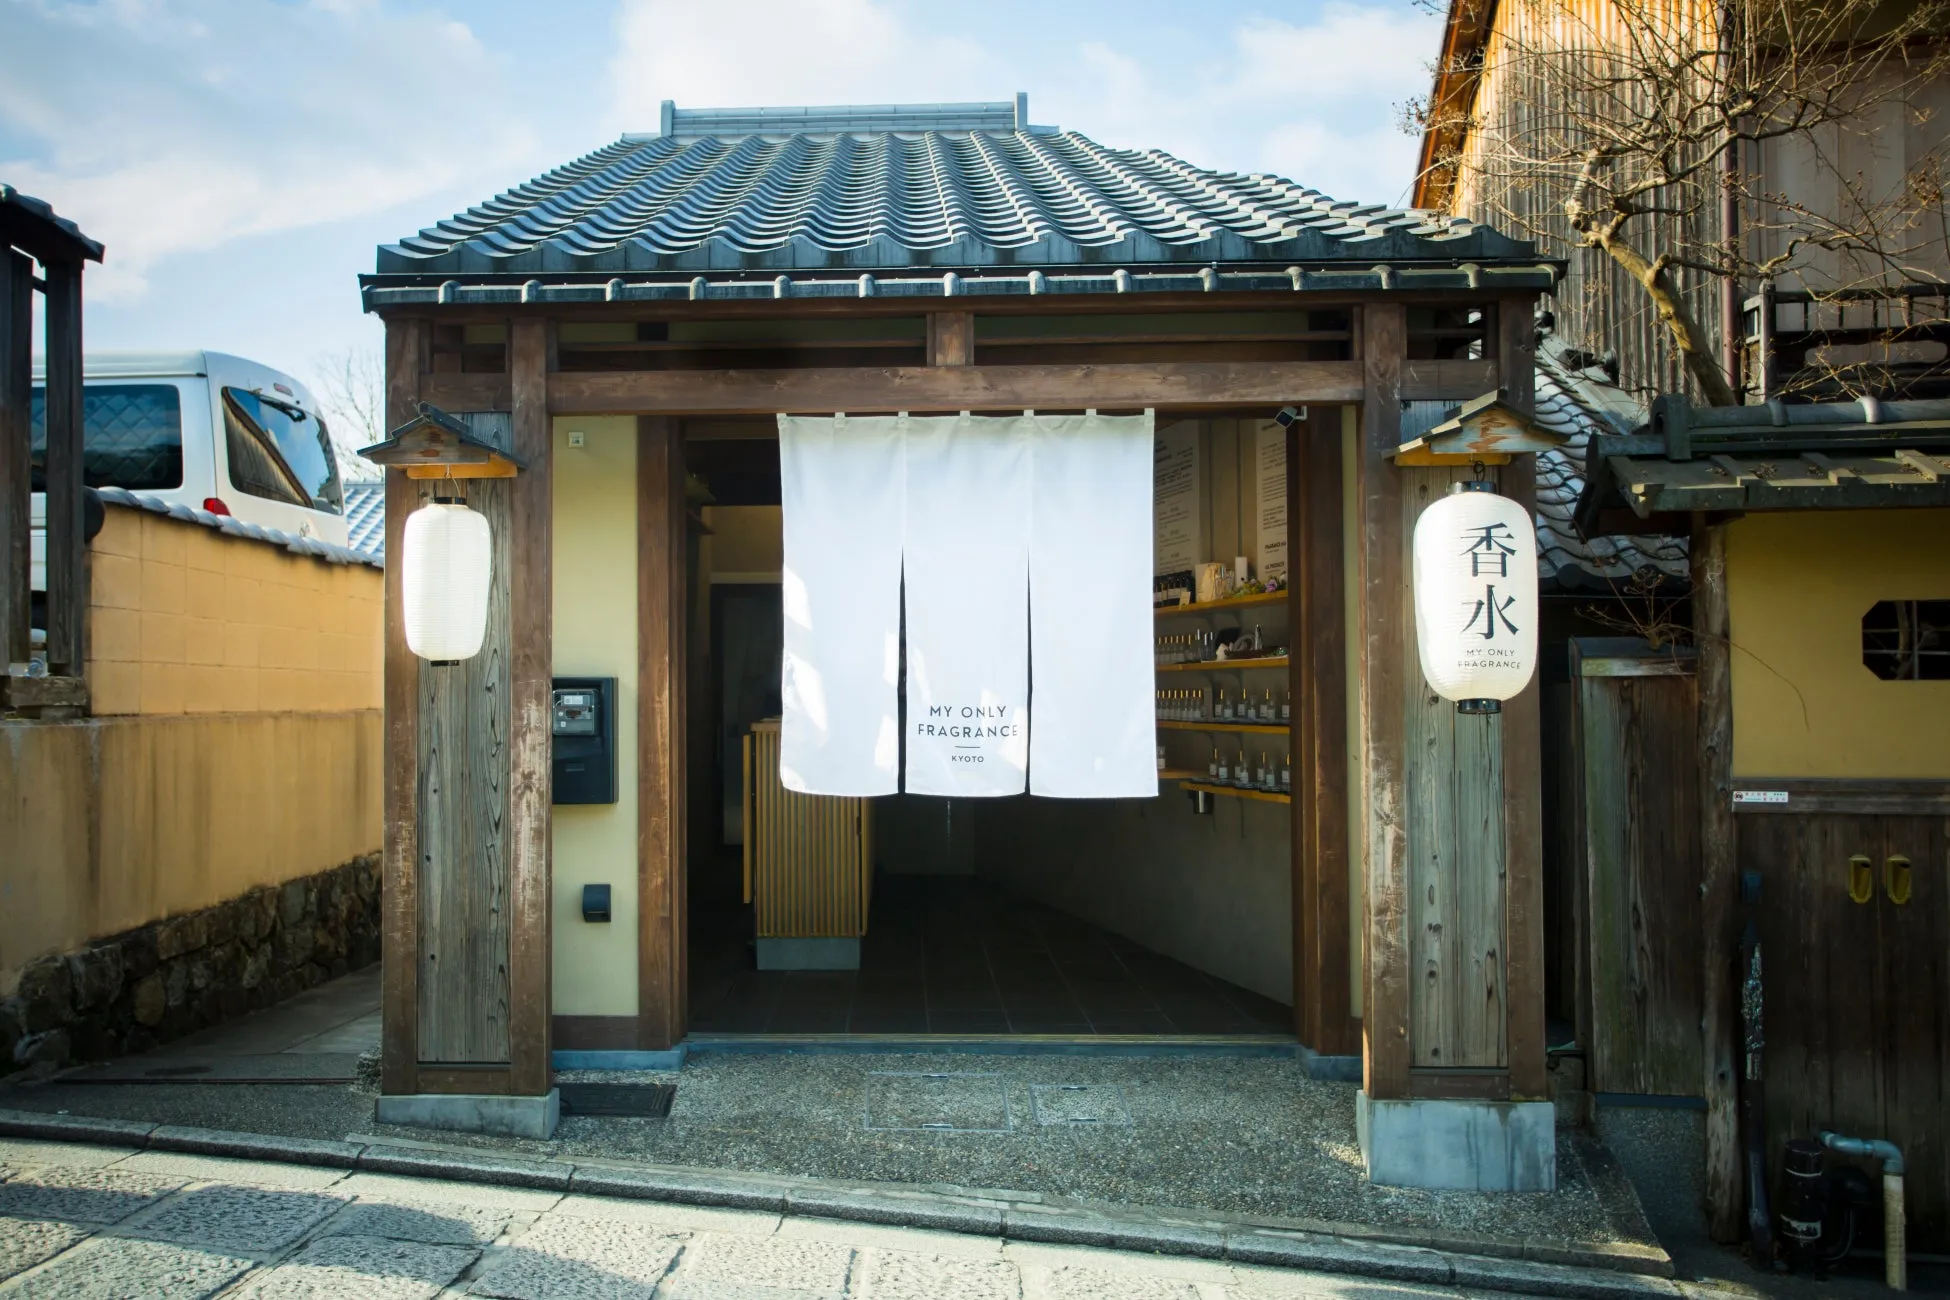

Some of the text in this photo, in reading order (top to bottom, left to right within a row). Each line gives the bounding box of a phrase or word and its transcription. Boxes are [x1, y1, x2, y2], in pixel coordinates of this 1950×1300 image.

[1459, 522, 1519, 640] 香水
[1466, 648, 1515, 656] MY ONLY
[1457, 660, 1520, 669] FRAGRANCE
[929, 705, 1007, 718] MY ONLY
[918, 723, 1018, 738] FRAGRANCE
[951, 755, 985, 763] KYOTO
